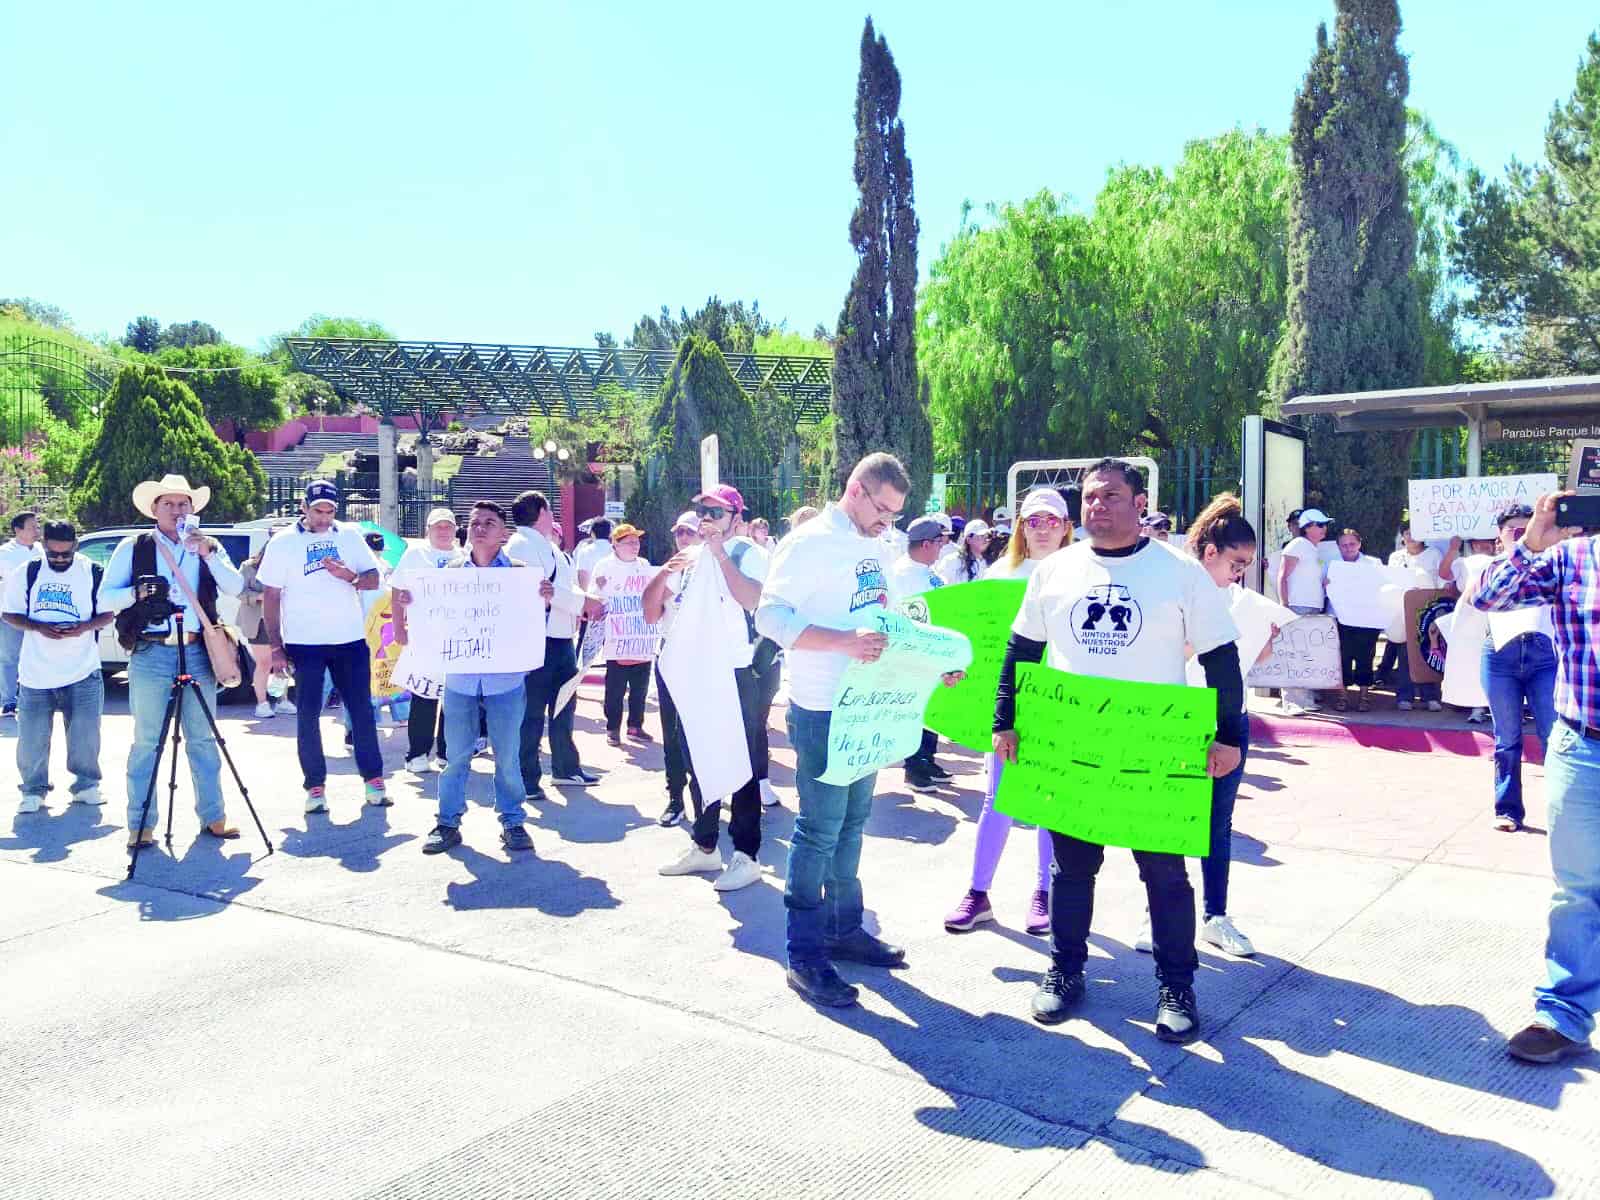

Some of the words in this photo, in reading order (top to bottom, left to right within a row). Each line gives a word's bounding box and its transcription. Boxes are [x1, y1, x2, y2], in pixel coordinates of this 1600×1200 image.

[1502, 427, 1546, 439] Parabús
[1549, 426, 1589, 438] Parque
[1431, 484, 1462, 501] POR
[1468, 481, 1508, 498] AMOR
[1515, 480, 1528, 496] A
[1428, 501, 1467, 515] CATA
[1432, 514, 1481, 534] ESTOY
[1081, 631, 1111, 639] JUNTOS
[1112, 632, 1129, 640] POR
[440, 638, 493, 661] HIJA!!
[1081, 639, 1126, 648] NUESTROS
[1088, 647, 1118, 656] HIJOS
